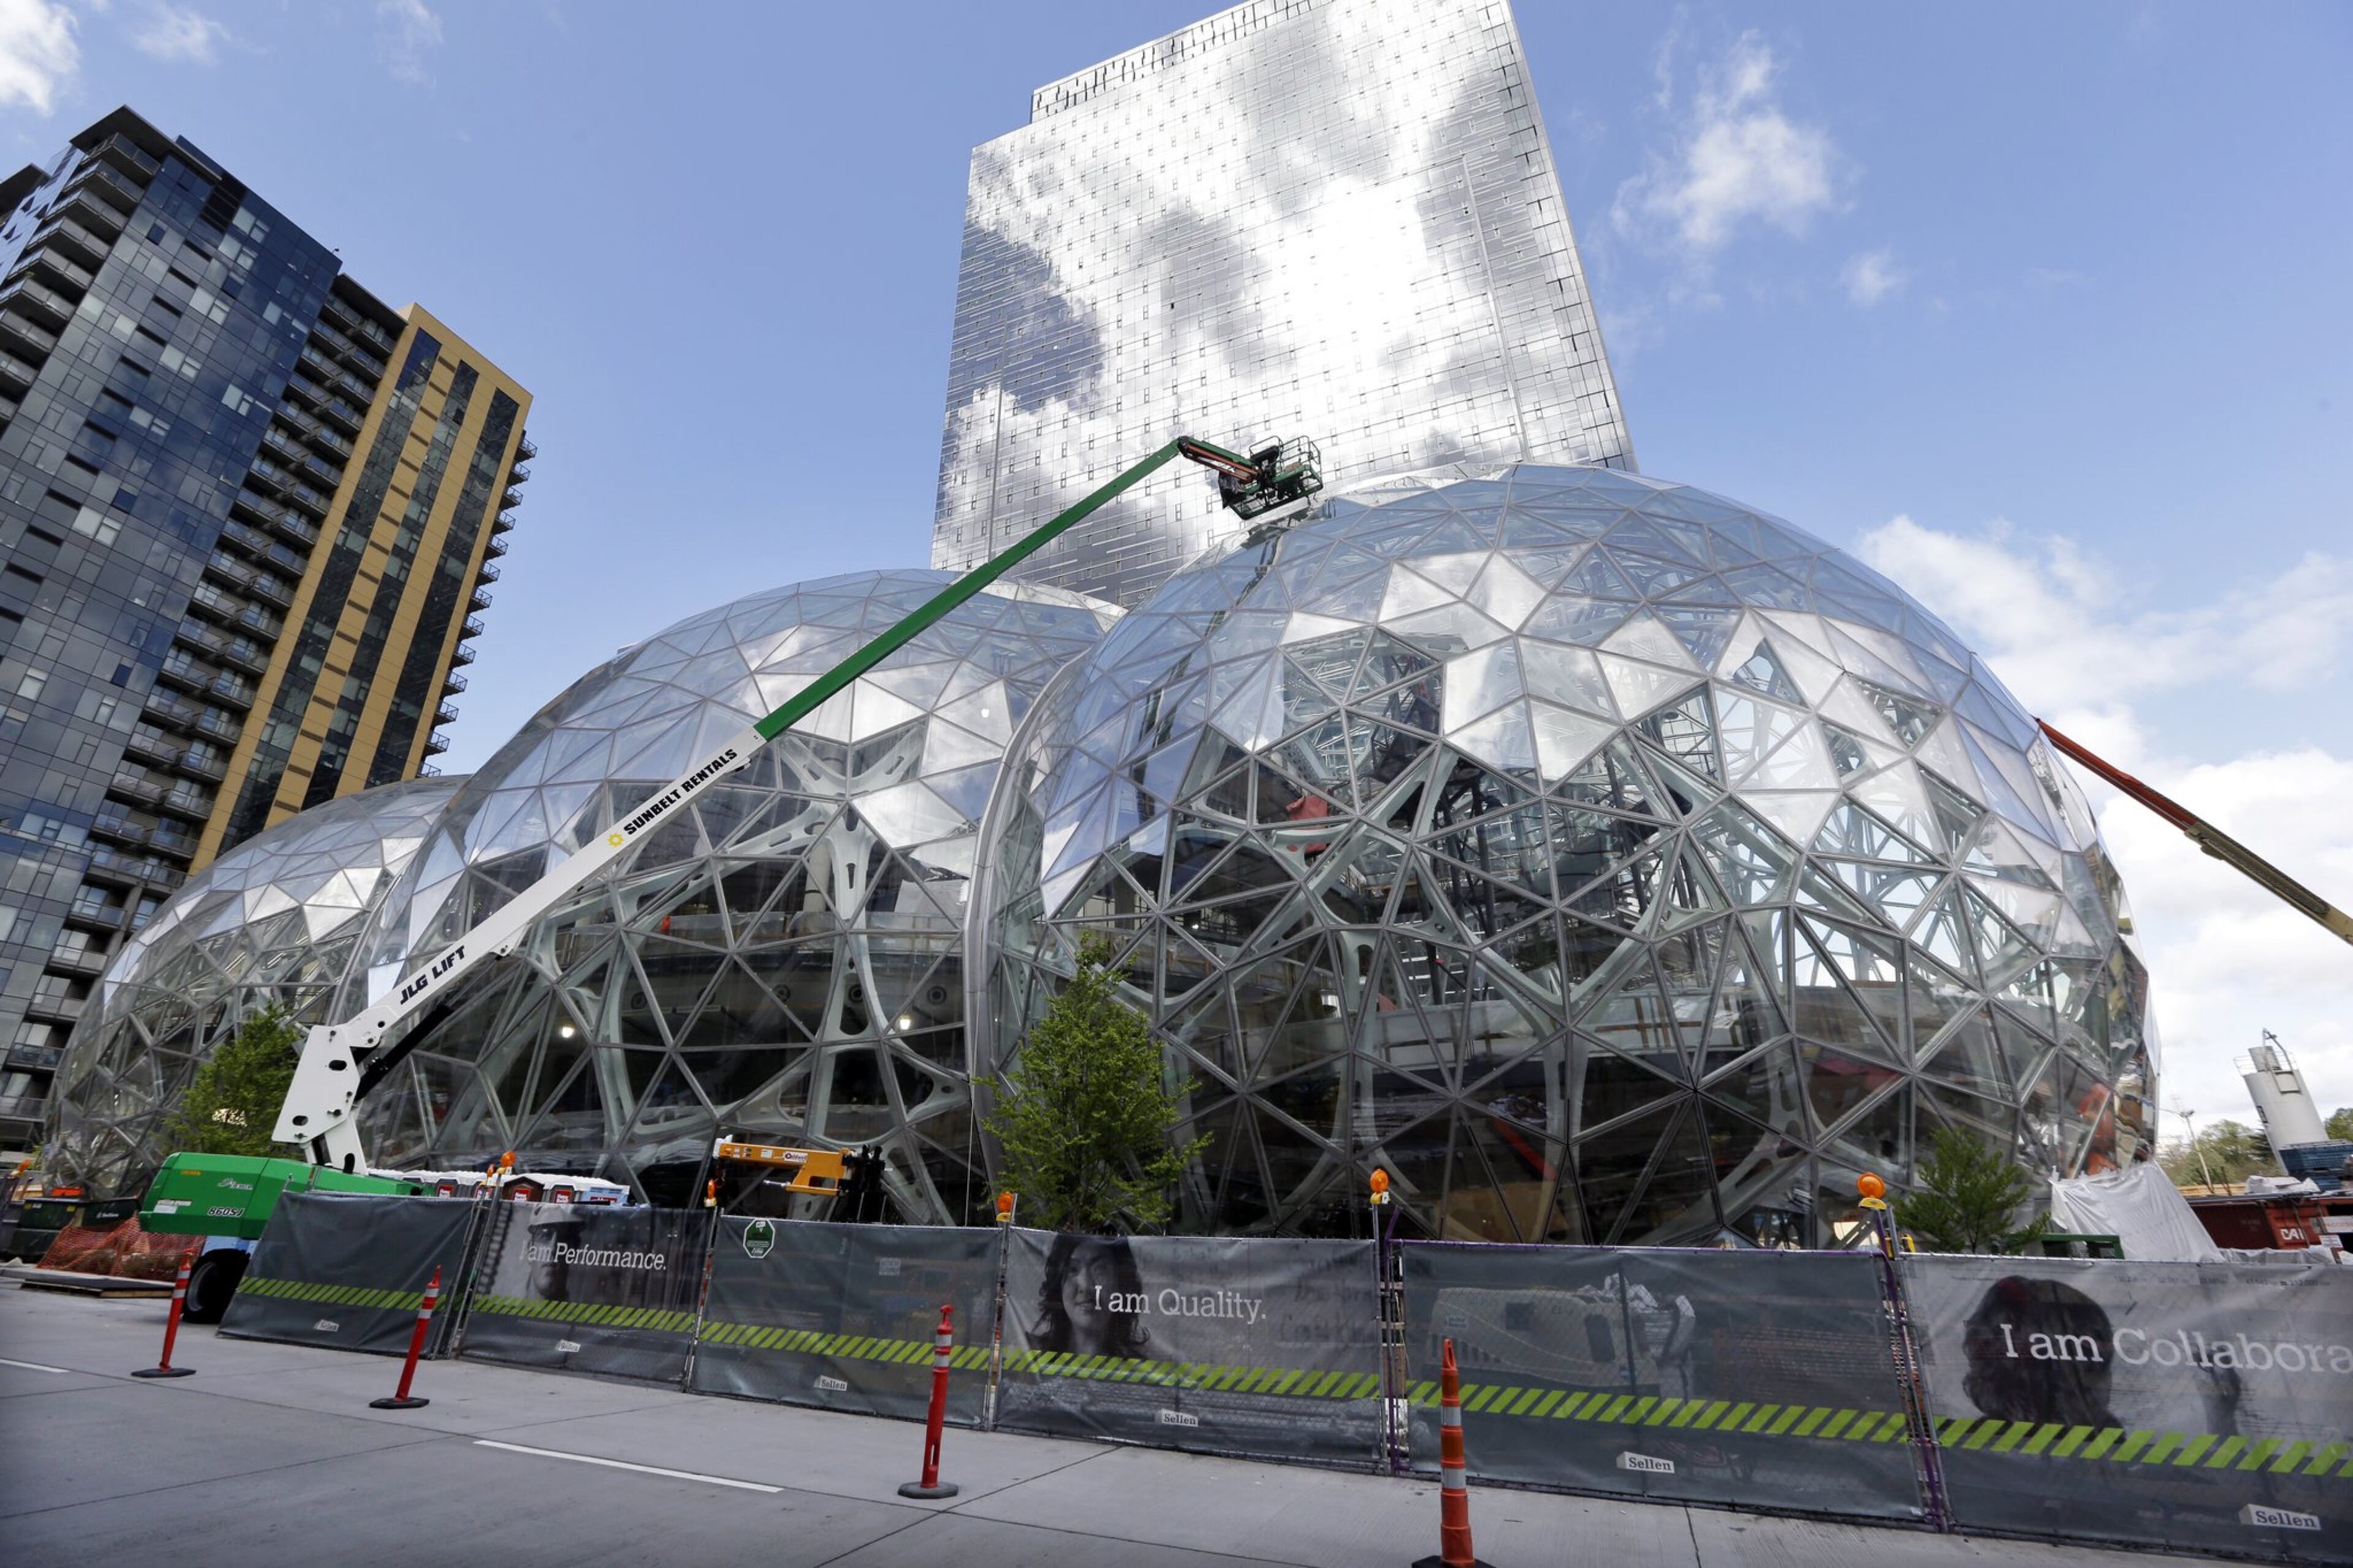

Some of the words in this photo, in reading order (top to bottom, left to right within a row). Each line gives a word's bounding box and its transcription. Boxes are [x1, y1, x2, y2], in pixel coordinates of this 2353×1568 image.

[624, 789, 681, 835] SUNBELT
[681, 749, 738, 792] RENTALS
[400, 974, 428, 1005] JLG
[432, 945, 464, 979] LIFT
[207, 1206, 244, 1217] 860SJ
[528, 1245, 551, 1262] am
[553, 1243, 667, 1270] Performance.
[1094, 1285, 1102, 1310] I
[1108, 1292, 1151, 1314] am
[1158, 1289, 1267, 1325] Quality.
[1999, 1324, 2018, 1358] I
[2029, 1332, 2104, 1362] am
[2112, 1328, 2353, 1374] Collabora
[822, 1379, 845, 1389] Sellen
[1164, 1413, 1196, 1425] Sellen
[1628, 1457, 1672, 1471] Sellen
[2255, 1510, 2316, 1527] Sellen
